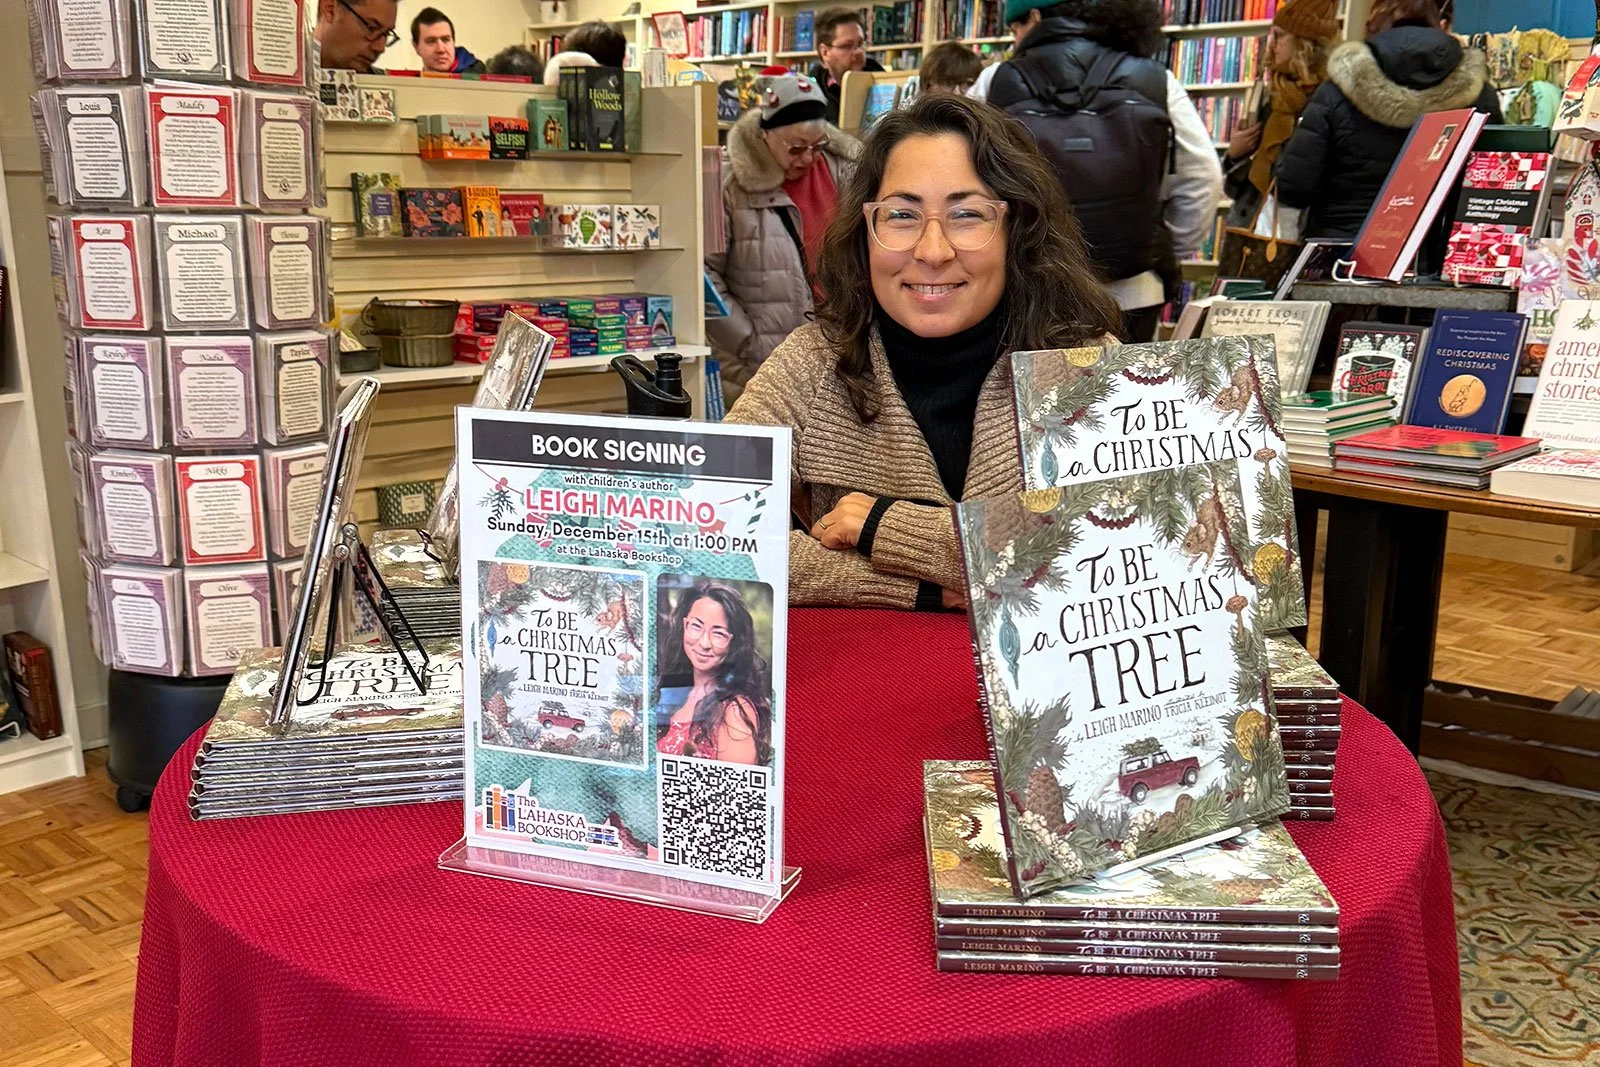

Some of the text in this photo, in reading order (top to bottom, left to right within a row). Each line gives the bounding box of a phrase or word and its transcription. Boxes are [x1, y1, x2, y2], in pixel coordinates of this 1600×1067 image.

[589, 88, 621, 101] Hollow
[80, 101, 102, 111] Louis
[594, 100, 623, 111] Woods
[495, 133, 526, 147] SELFISH
[1493, 205, 1520, 214] Holiday
[1495, 198, 1529, 207] Christmas
[178, 229, 219, 239] Michael
[1214, 307, 1308, 320] ROBERT FROST
[1436, 348, 1511, 361] REDISCOVERING
[1444, 359, 1498, 370] CHRISTMAS
[1340, 370, 1399, 390] CHRISTMAS
[1110, 398, 1188, 436] To BE
[532, 434, 706, 467] BOOK SIGNING
[1059, 427, 1252, 479] a CHRISTMAS
[564, 474, 674, 492] with children's author
[525, 488, 716, 525] LEIGH MARINO
[487, 517, 758, 553] Sunday, December 15th at 1:00 PM
[556, 545, 682, 566] at the Lahaska Bookshop
[1075, 543, 1159, 593] To BE
[531, 607, 578, 632] To BE
[1022, 574, 1224, 656] a CHRISTMAS
[497, 628, 618, 656] a CHRISTMAS
[334, 657, 373, 669] To
[520, 649, 600, 688] TREE
[1068, 624, 1207, 712] TREE
[523, 683, 542, 694] LEIGH
[543, 686, 568, 698] MARINO
[315, 696, 342, 704] EIGH
[344, 693, 393, 702] MARINO
[1083, 717, 1118, 741] LEIGH
[1119, 704, 1162, 732] MARINO
[517, 795, 537, 808] The
[518, 808, 586, 829] LAHASKA
[517, 821, 587, 843] BOOKSHOP
[966, 908, 1046, 918] LEIGH MARINO
[1080, 909, 1096, 919] To
[1125, 911, 1188, 922] CHRISTMAS
[1191, 912, 1221, 922] TREE
[966, 928, 1047, 938] LEIGH MARINO
[1080, 928, 1096, 938] To
[1125, 930, 1189, 940] CHRISTMAS
[1193, 932, 1222, 941] TREE
[961, 942, 1042, 953] LEIGH MARINO
[1077, 945, 1092, 955] To
[1122, 947, 1186, 958] CHRISTMAS
[1189, 950, 1217, 960] TREE
[963, 963, 1044, 973] LEIGH MARINO
[1078, 964, 1094, 974] To
[1123, 965, 1187, 976] CHRISTMAS
[1190, 967, 1219, 977] TREE
